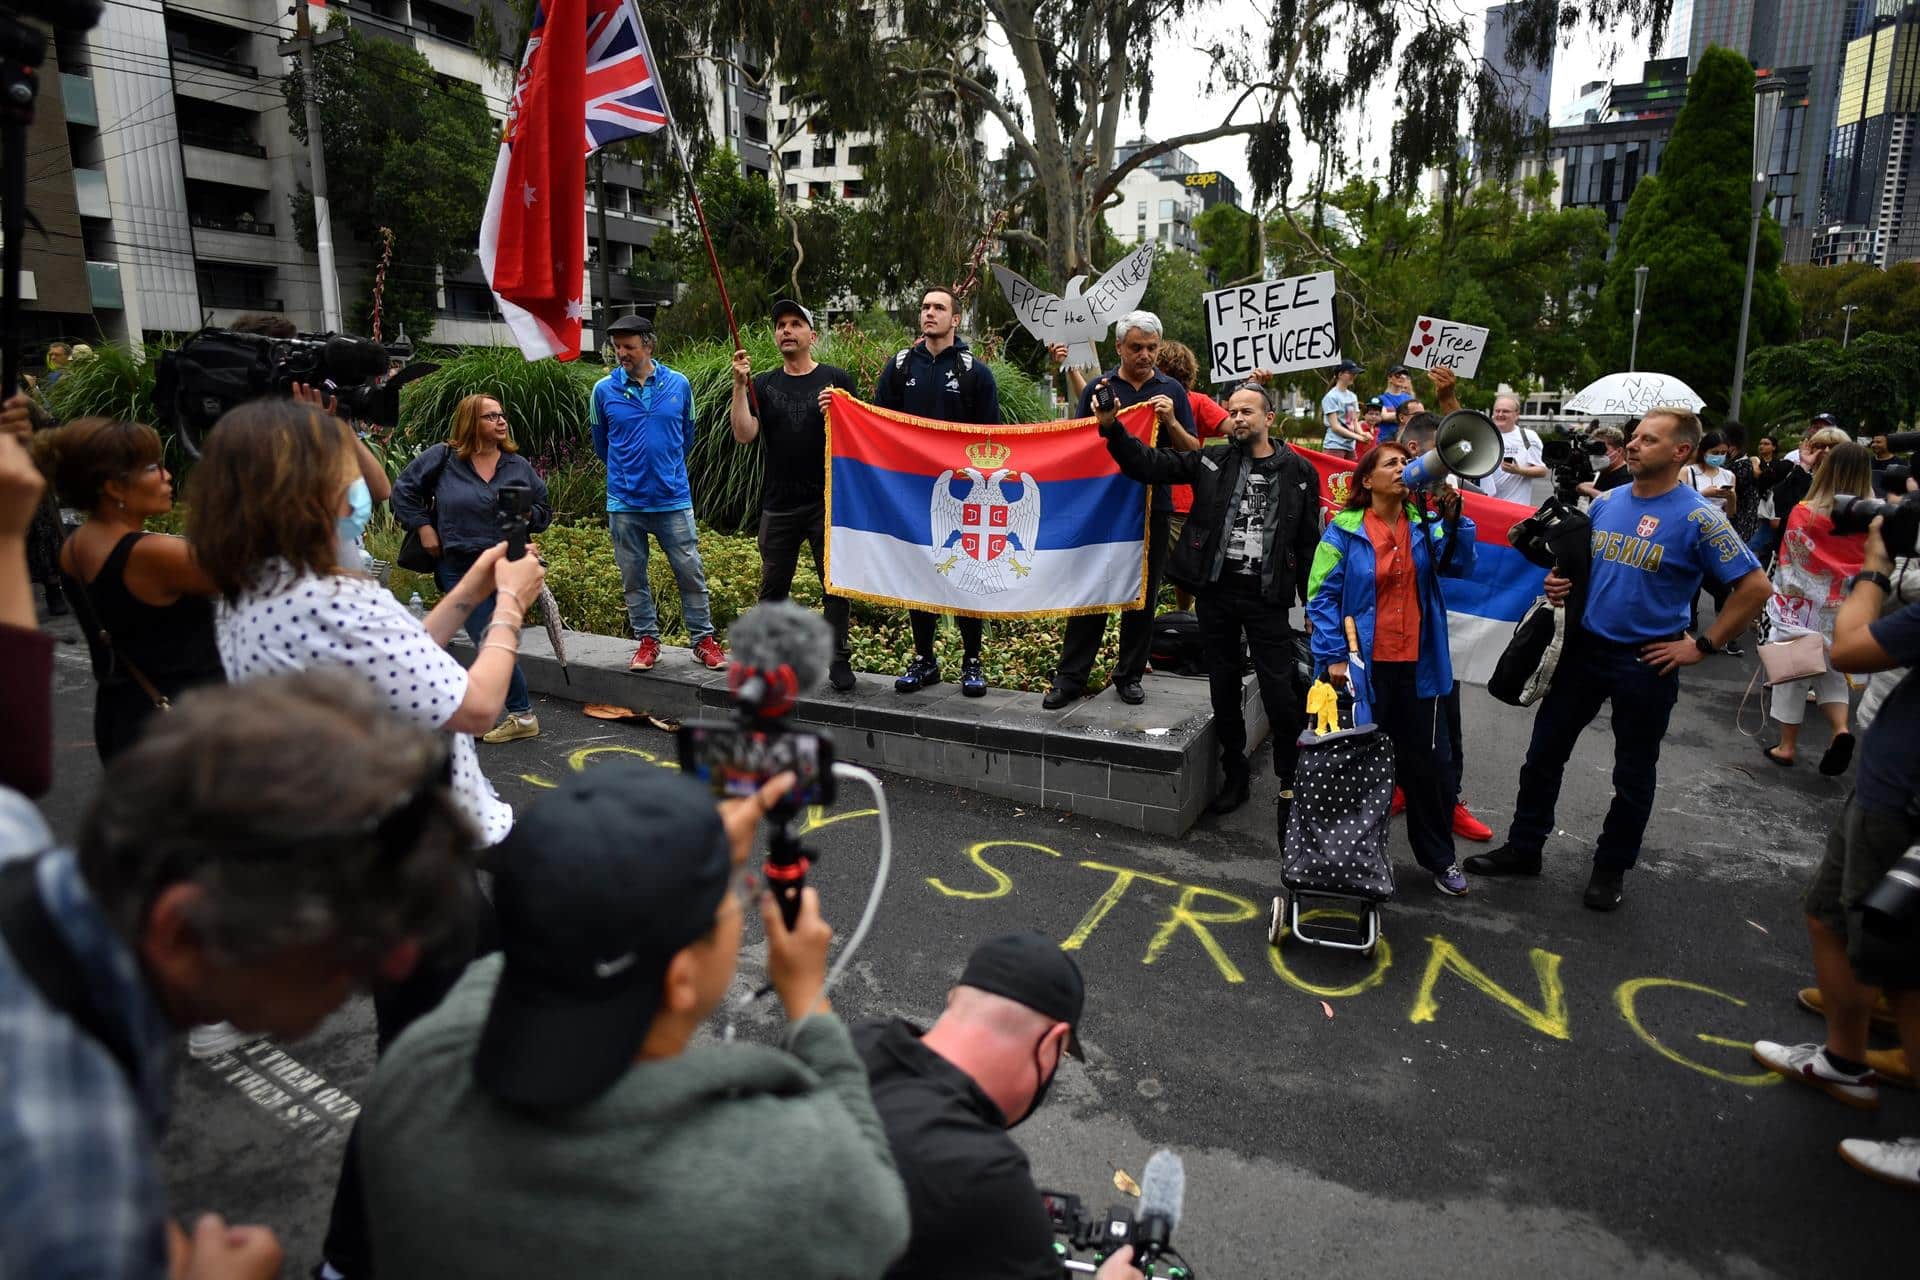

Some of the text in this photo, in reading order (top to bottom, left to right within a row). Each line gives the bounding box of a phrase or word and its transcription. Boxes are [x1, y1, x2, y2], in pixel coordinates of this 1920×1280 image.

[1185, 173, 1217, 188] scape
[1011, 244, 1153, 328] FREE the REFUGEES
[1215, 276, 1319, 326] FREE
[1242, 312, 1281, 332] THE
[1214, 322, 1336, 377] REFUGEES
[1438, 326, 1477, 352] Free
[1425, 347, 1464, 369] Hugs
[1622, 377, 1665, 388] NO
[1628, 386, 1664, 401] VAX
[925, 841, 1785, 1087] STRONG
